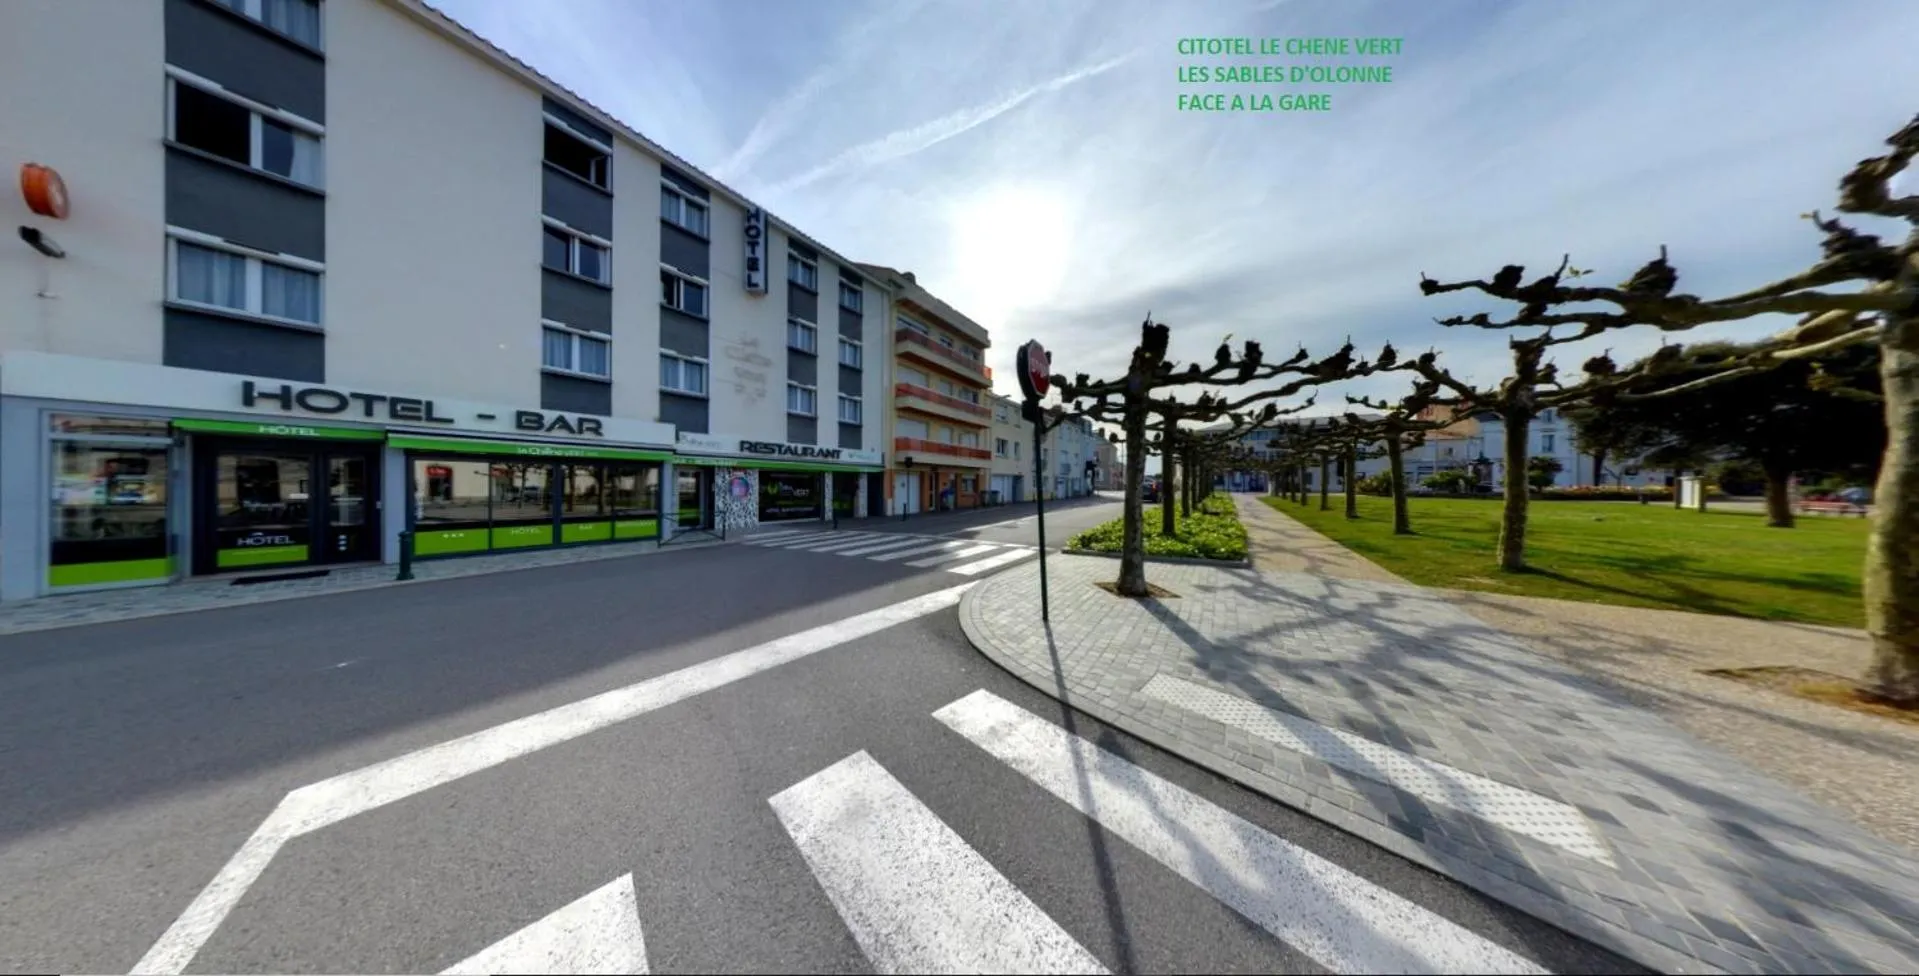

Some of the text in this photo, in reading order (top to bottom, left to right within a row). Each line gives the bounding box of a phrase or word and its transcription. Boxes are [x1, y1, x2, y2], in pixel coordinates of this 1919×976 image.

[744, 209, 761, 288] HOTEL
[242, 380, 454, 423] HOTEL
[515, 409, 603, 436] BAR
[740, 440, 842, 459] RESTAURANT
